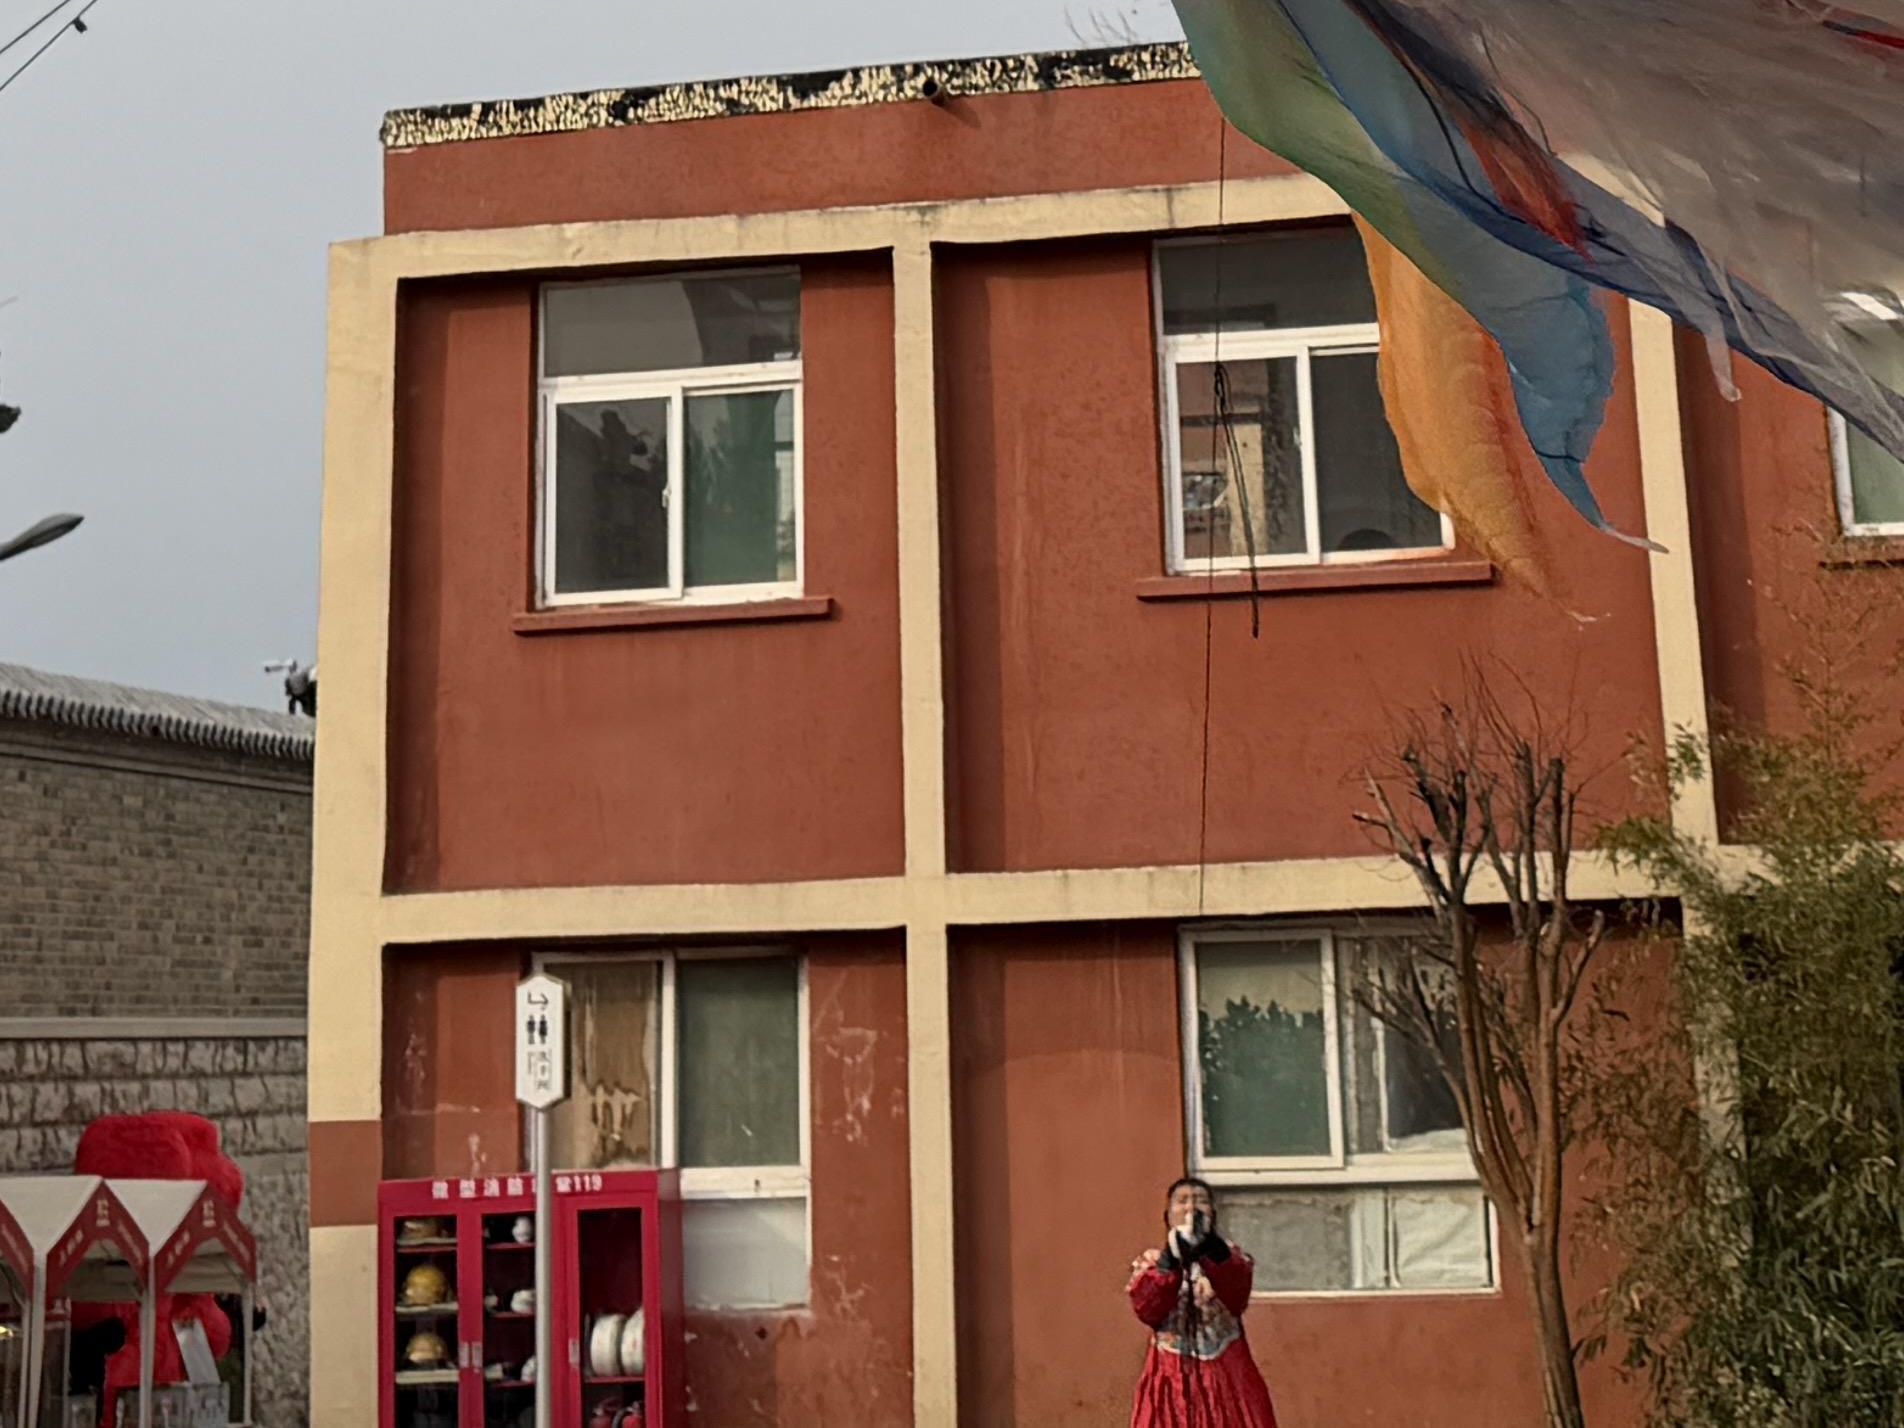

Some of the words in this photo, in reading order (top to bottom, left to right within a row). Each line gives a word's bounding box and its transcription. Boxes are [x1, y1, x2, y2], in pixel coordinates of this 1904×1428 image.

[432, 1175, 536, 1199] 微型消防
[573, 1174, 602, 1192] 119
